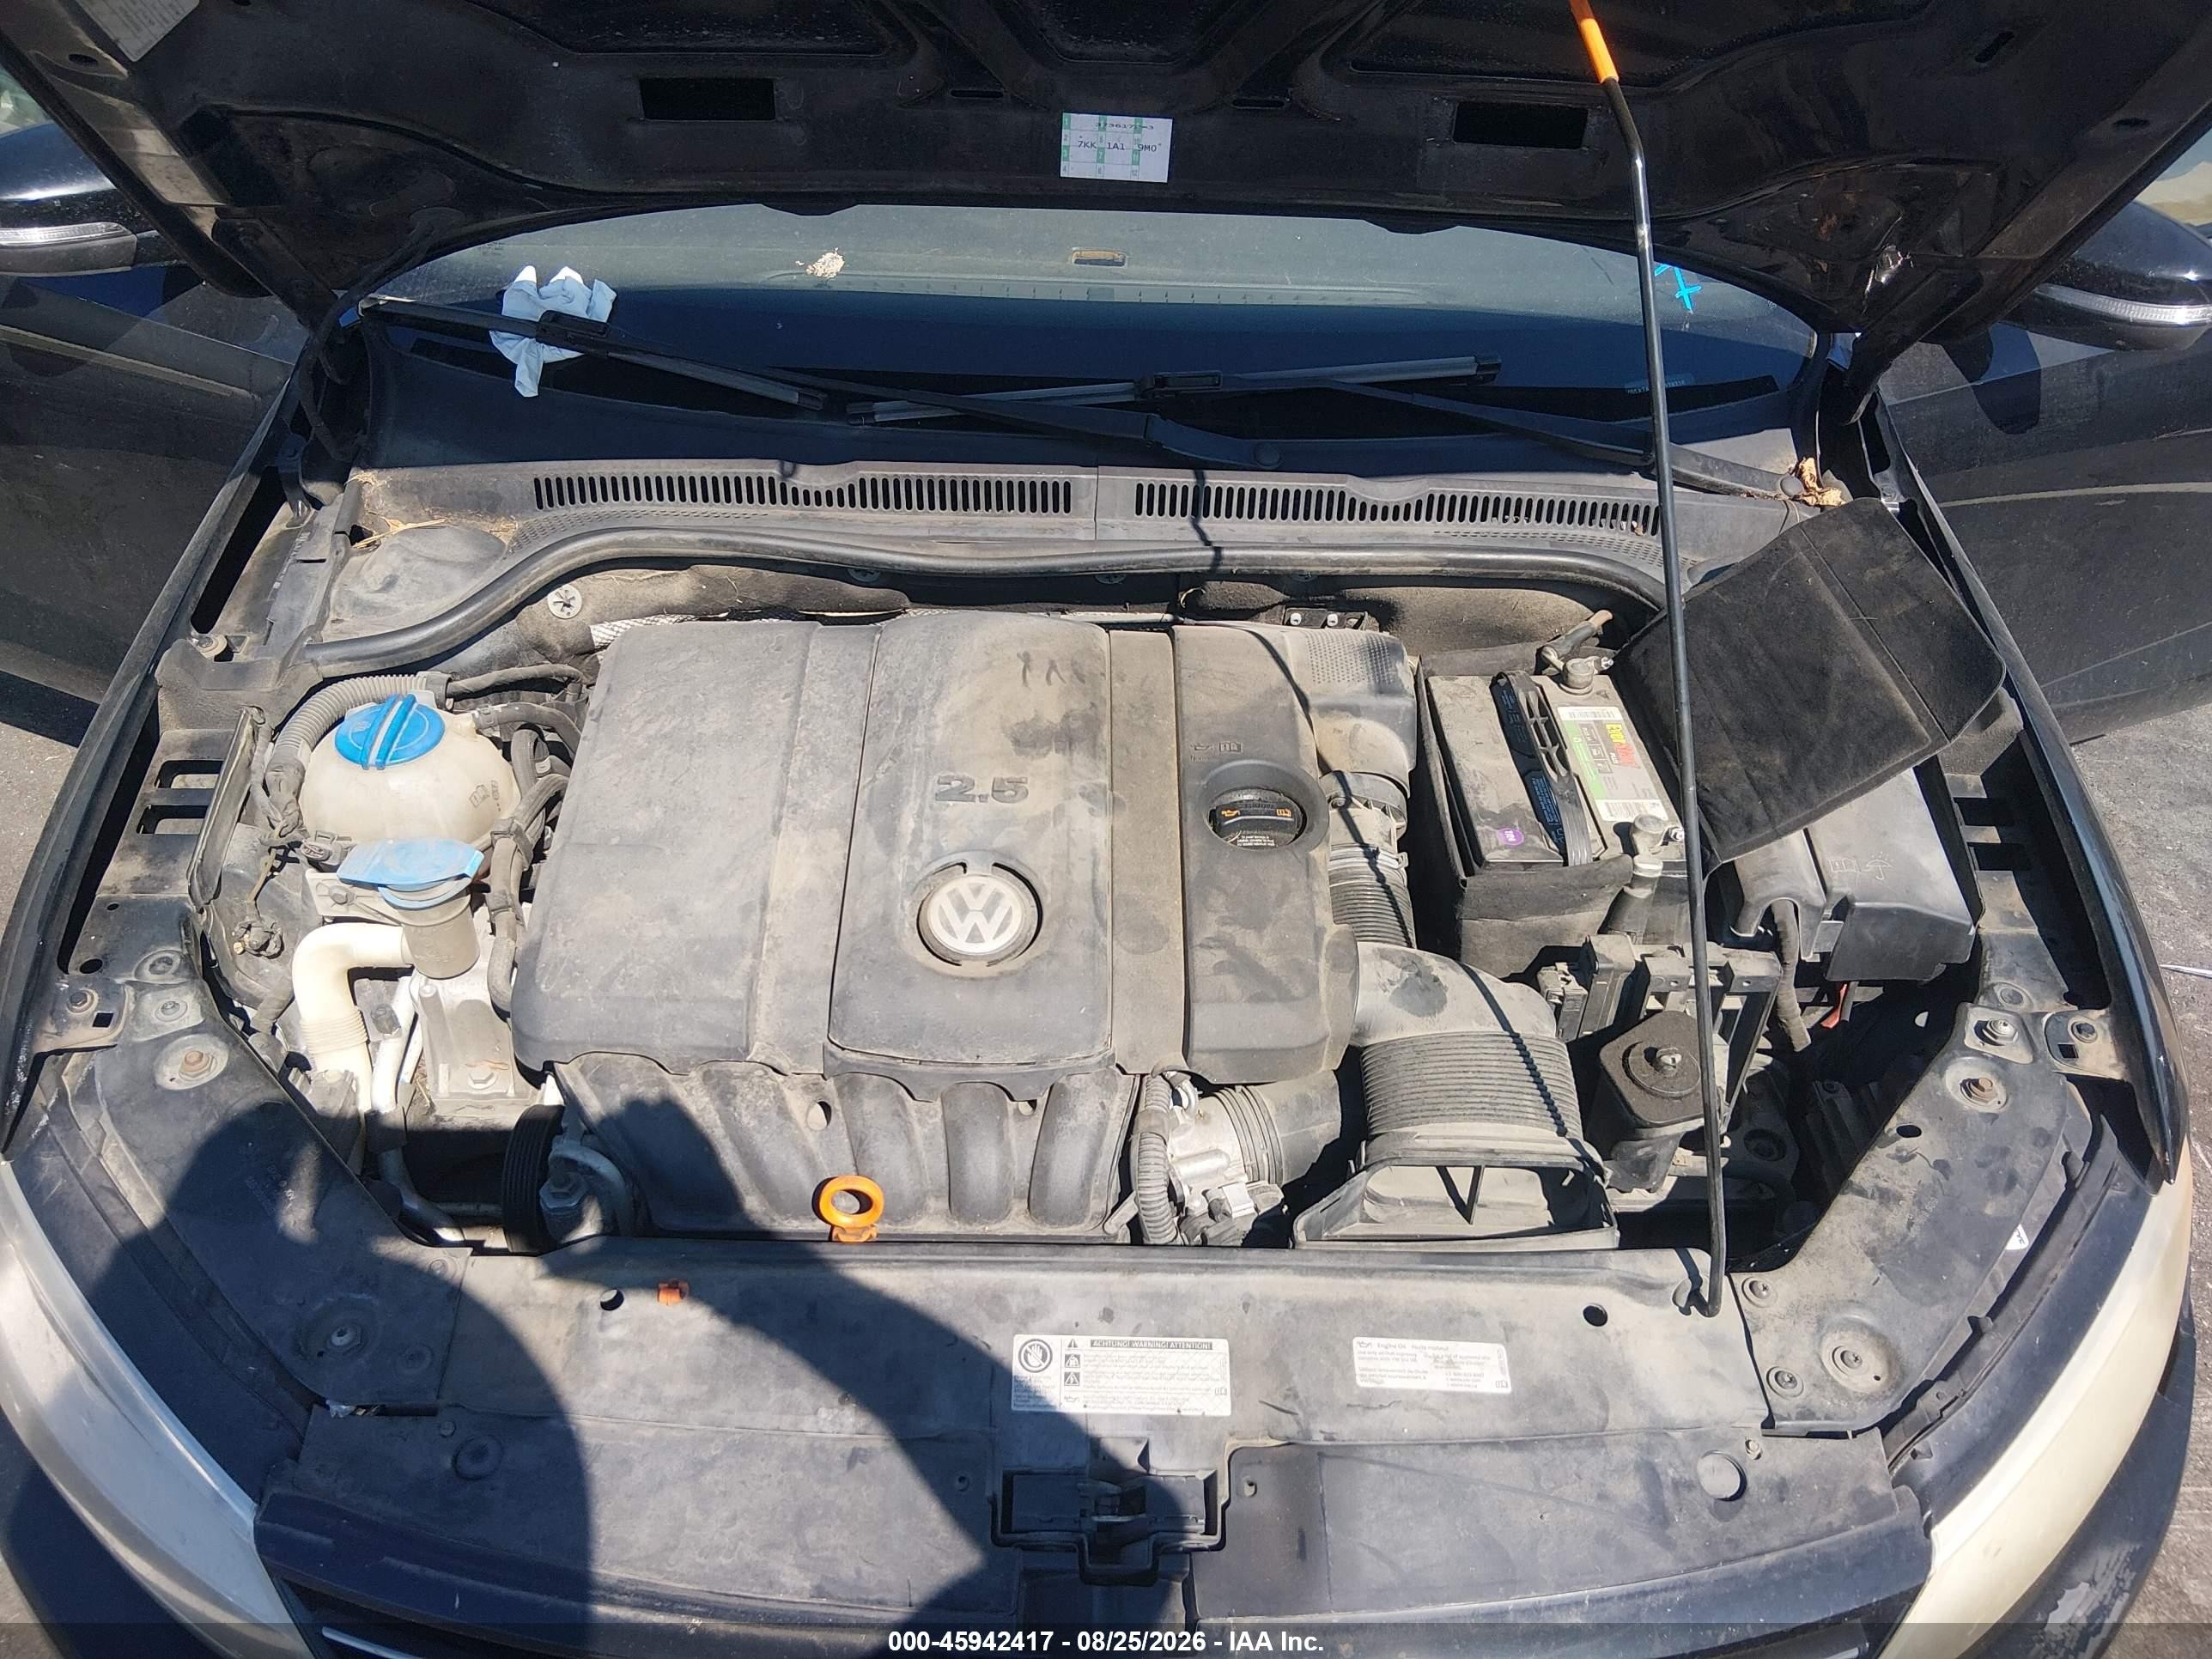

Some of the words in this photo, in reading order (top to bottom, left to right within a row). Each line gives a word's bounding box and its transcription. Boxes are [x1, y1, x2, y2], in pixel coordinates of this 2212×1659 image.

[1078, 140, 1097, 149] 7KK
[1107, 142, 1126, 151] 1A1
[934, 775, 1029, 804] 2.5
[933, 878, 1018, 951] VW
[1132, 1340, 1168, 1349] WARNING!
[1169, 1341, 1212, 1350] ATTENTION!
